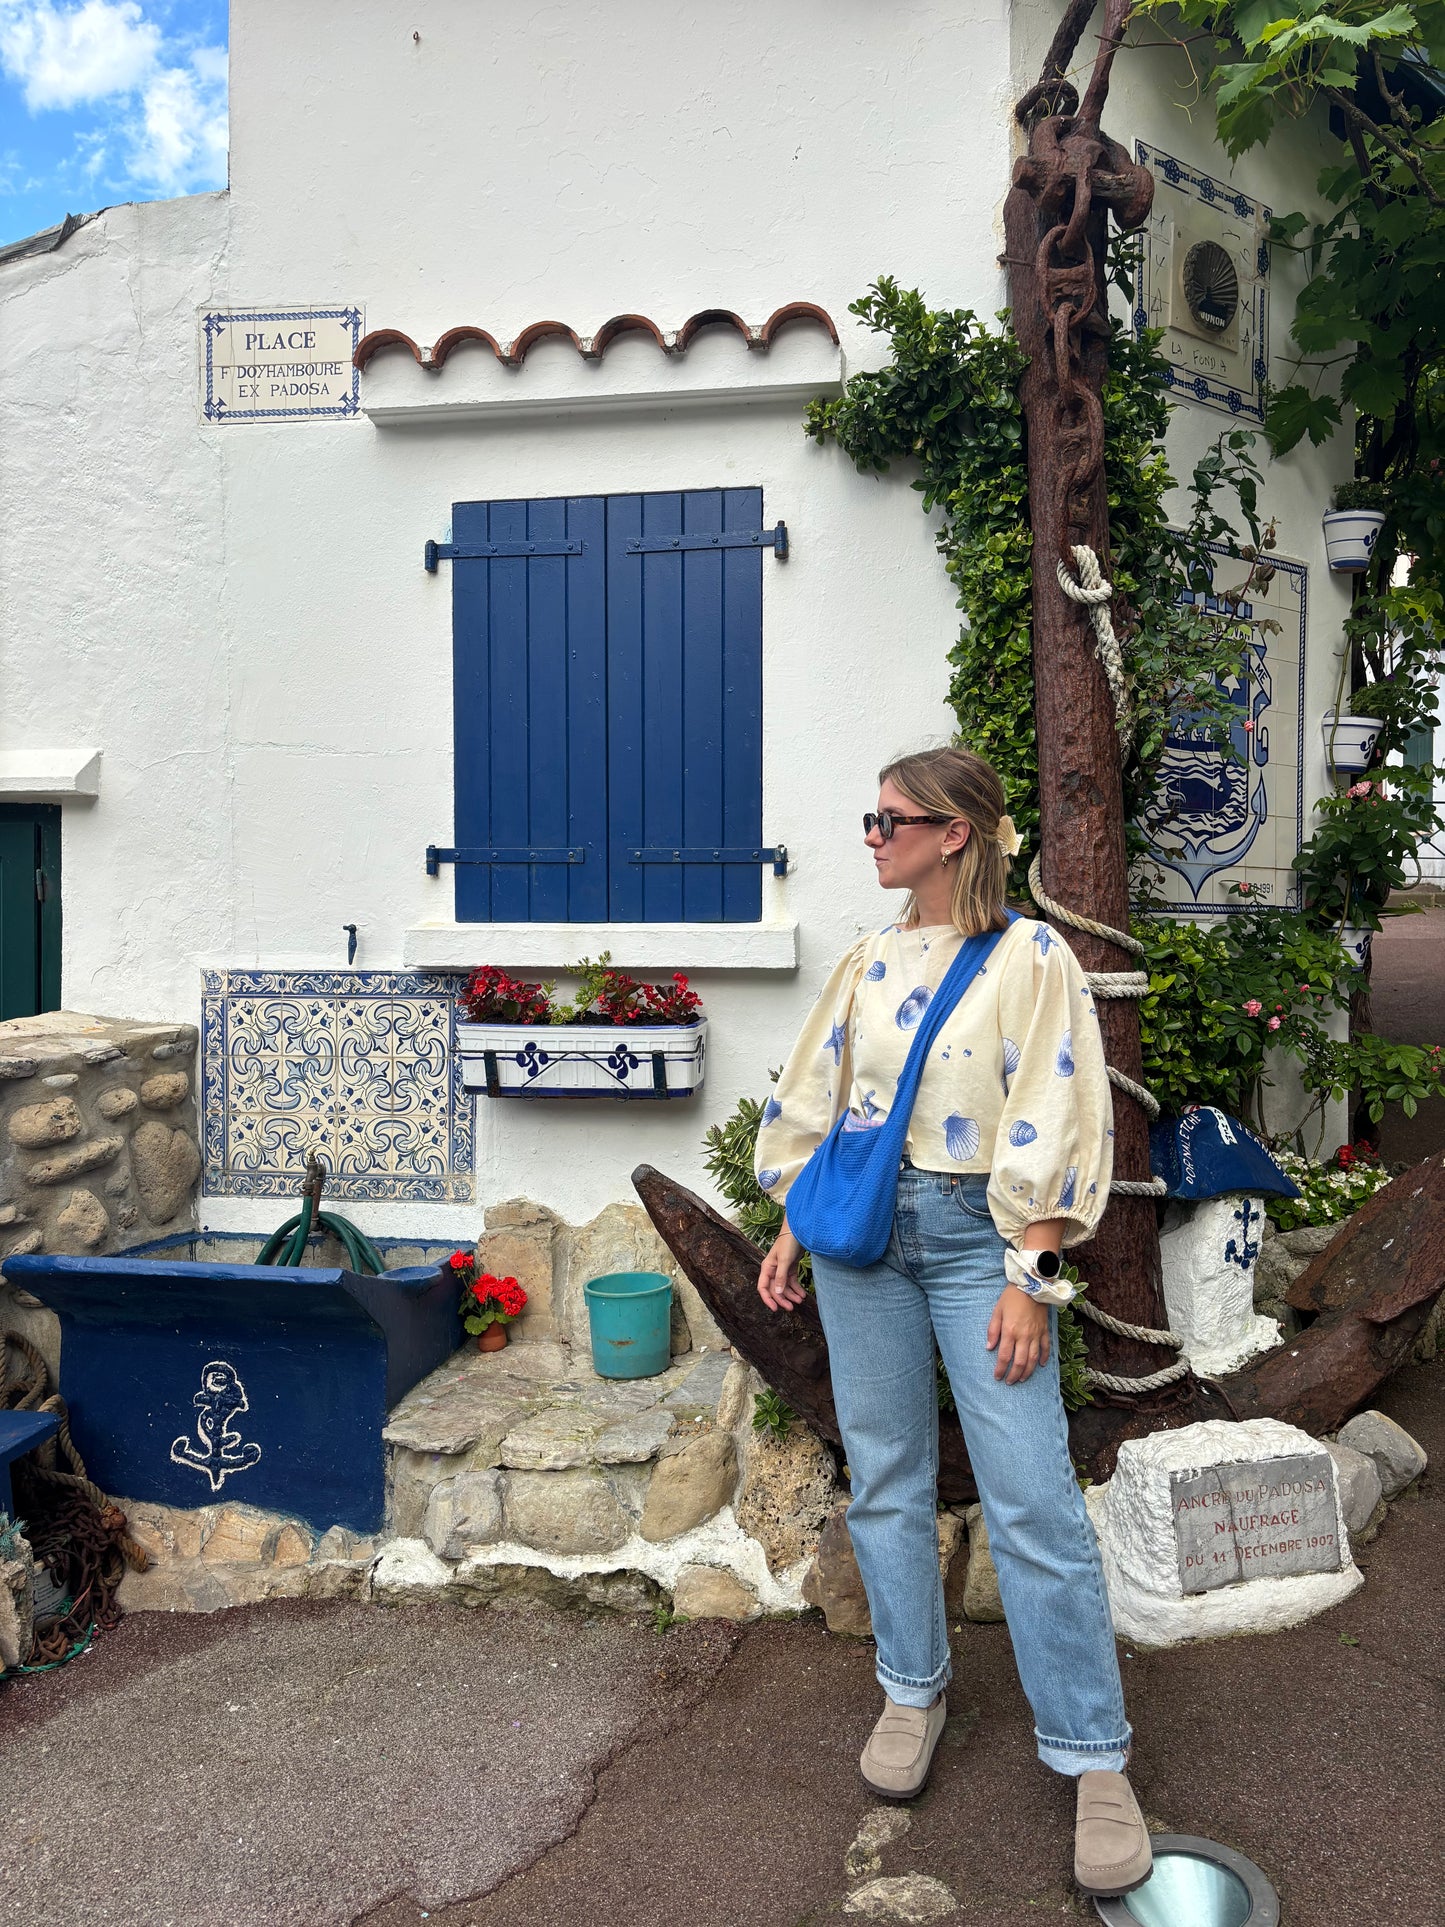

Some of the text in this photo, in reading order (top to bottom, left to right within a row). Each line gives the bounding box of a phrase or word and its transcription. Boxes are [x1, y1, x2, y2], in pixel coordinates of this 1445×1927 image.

[245, 331, 316, 350] PLACE
[1171, 341, 1182, 355] LA
[221, 362, 343, 379] F DOYHAMBOURE
[239, 382, 330, 397] EX PADOSA
[1254, 662, 1268, 685] ME
[1178, 1479, 1326, 1511] ANCRE DU PADOSA
[1214, 1509, 1299, 1534] NAUFRAGE
[1186, 1554, 1203, 1567] DU
[1213, 1551, 1226, 1563] 11
[1234, 1539, 1302, 1559] DECEMBRE
